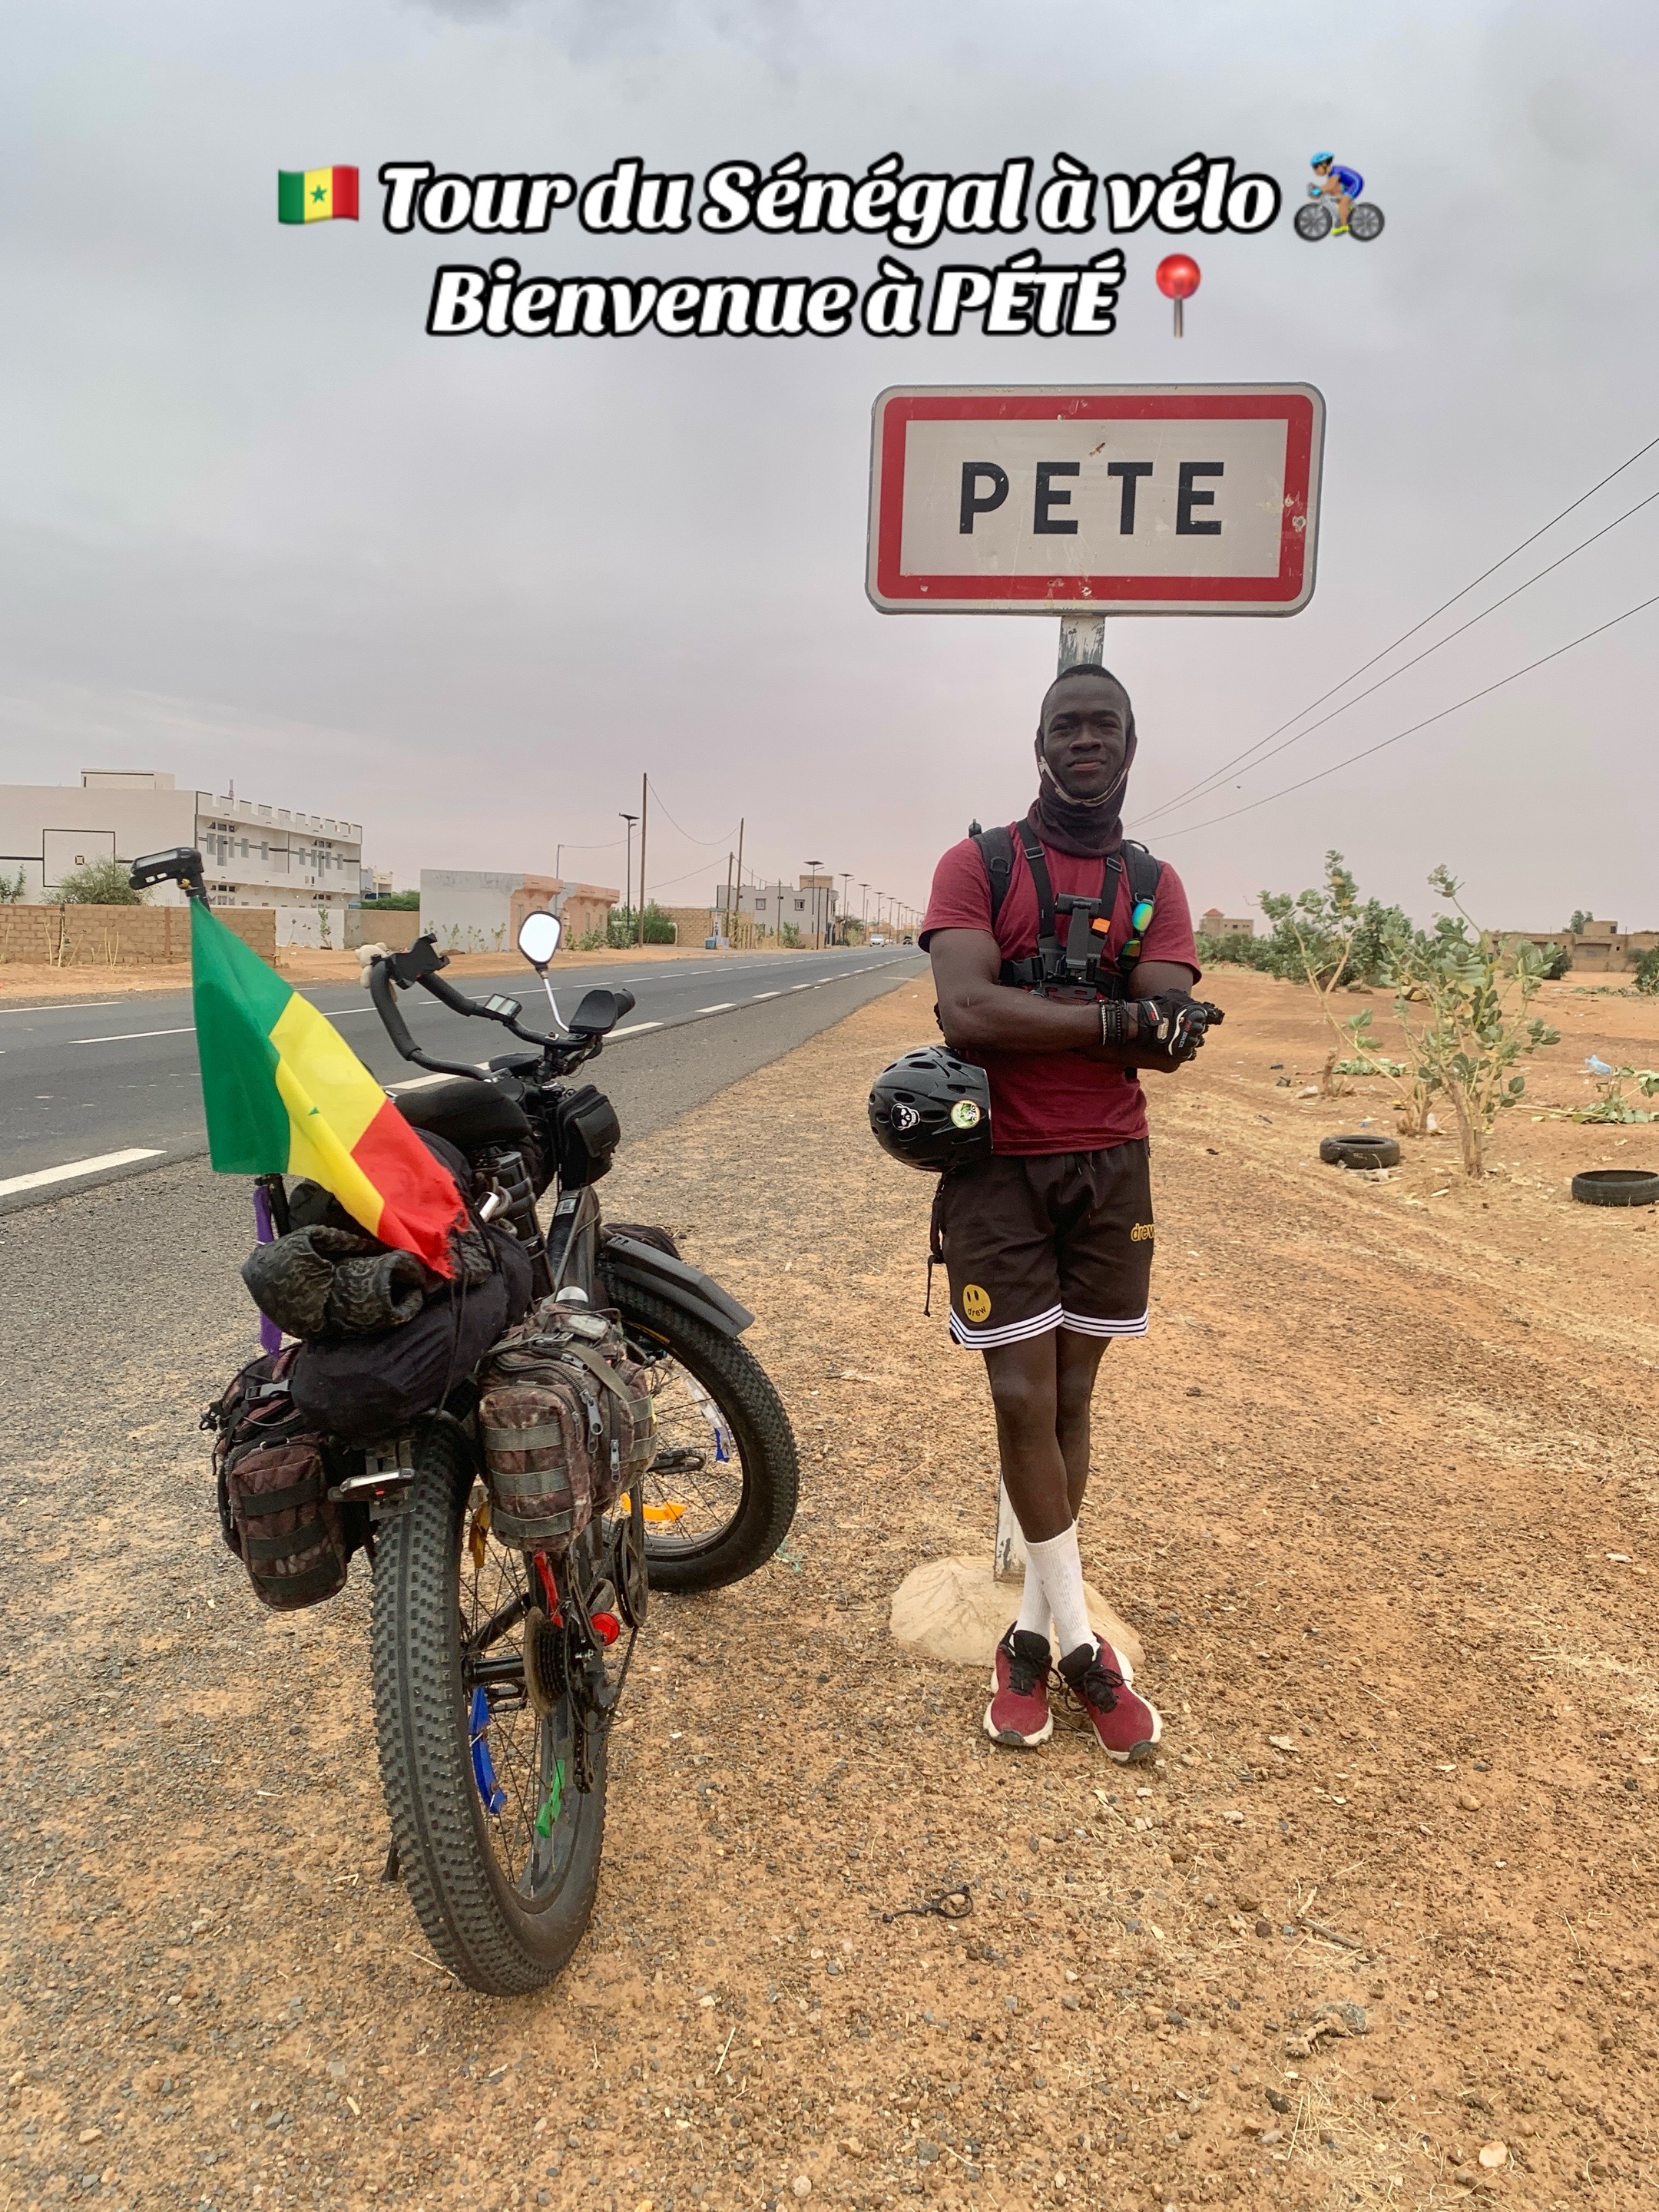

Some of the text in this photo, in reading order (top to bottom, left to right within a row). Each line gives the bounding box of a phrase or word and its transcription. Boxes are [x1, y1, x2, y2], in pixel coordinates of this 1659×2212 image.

[959, 461, 1224, 535] PETE
[1178, 1031, 1188, 1048] BIKER
[967, 1306, 987, 1316] drew
